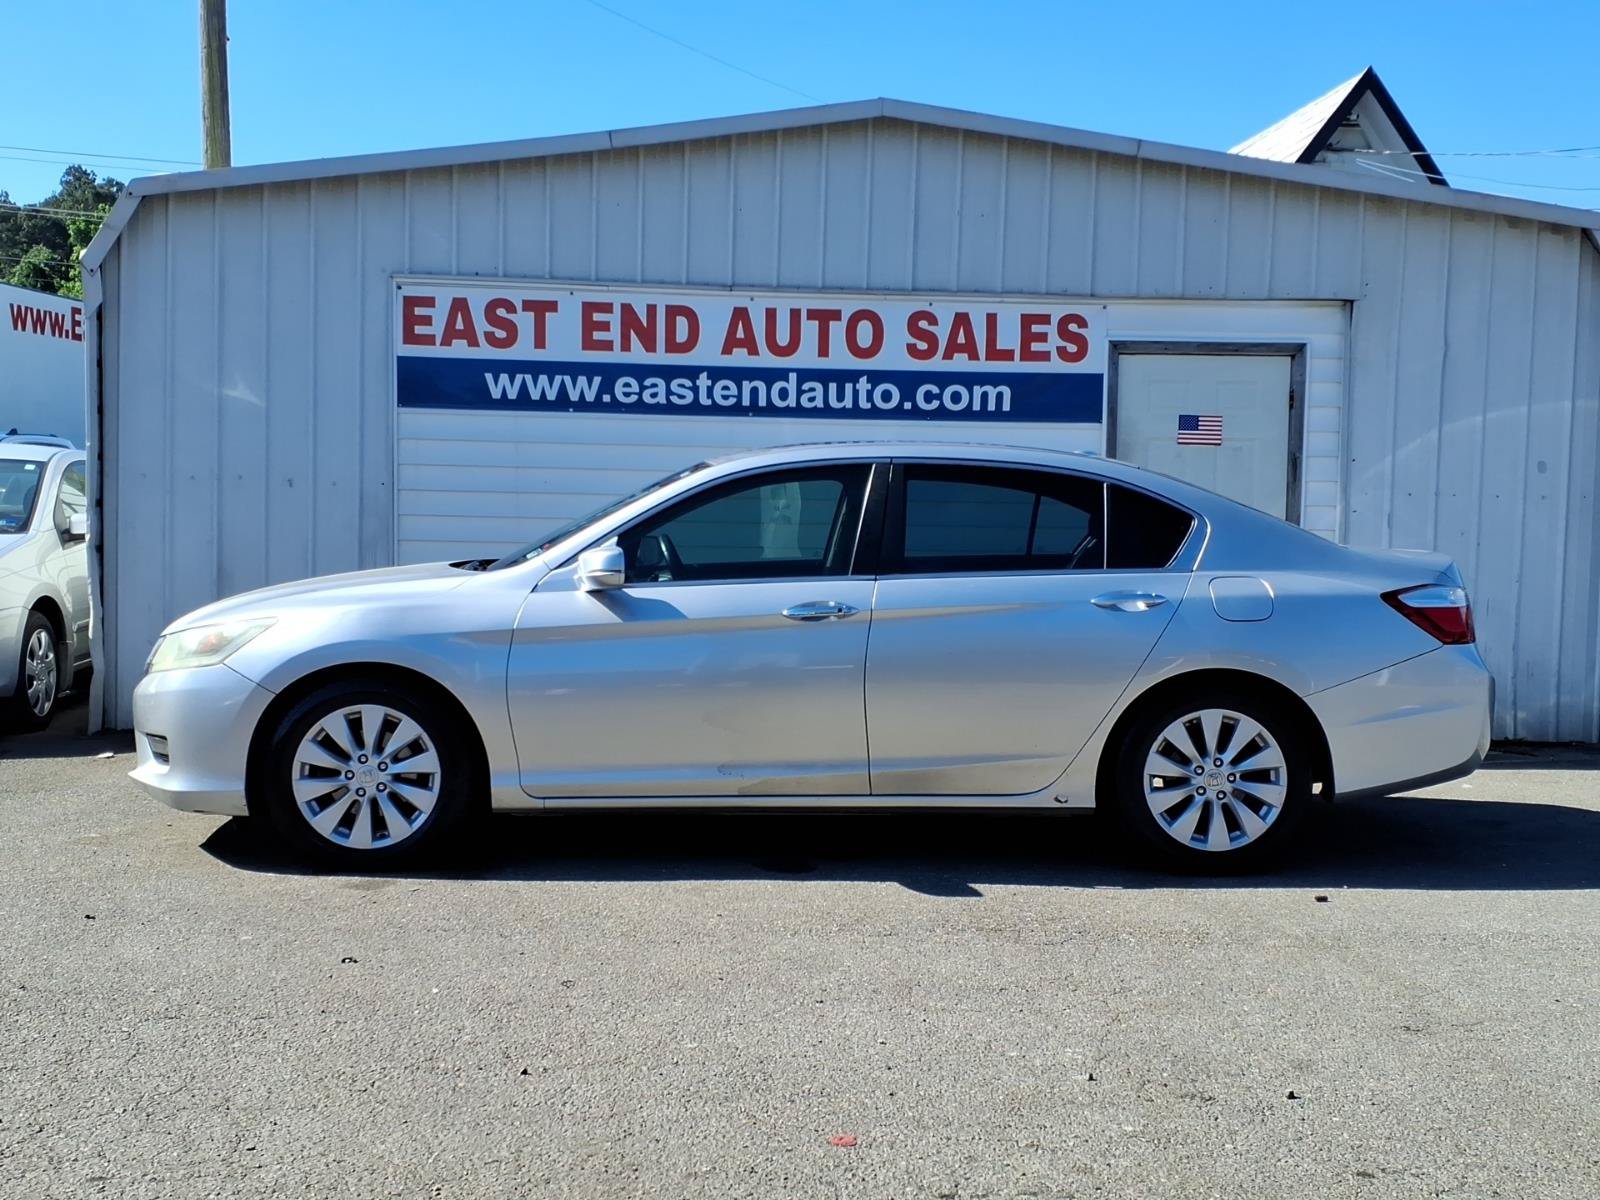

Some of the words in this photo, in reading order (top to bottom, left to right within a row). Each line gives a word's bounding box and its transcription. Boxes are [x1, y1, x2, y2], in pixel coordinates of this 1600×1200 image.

[402, 296, 558, 350] EAST
[581, 301, 701, 354] END
[721, 306, 885, 359] AUTO
[905, 310, 1090, 363] SALES
[485, 371, 1011, 412] www.eastendauto.com
